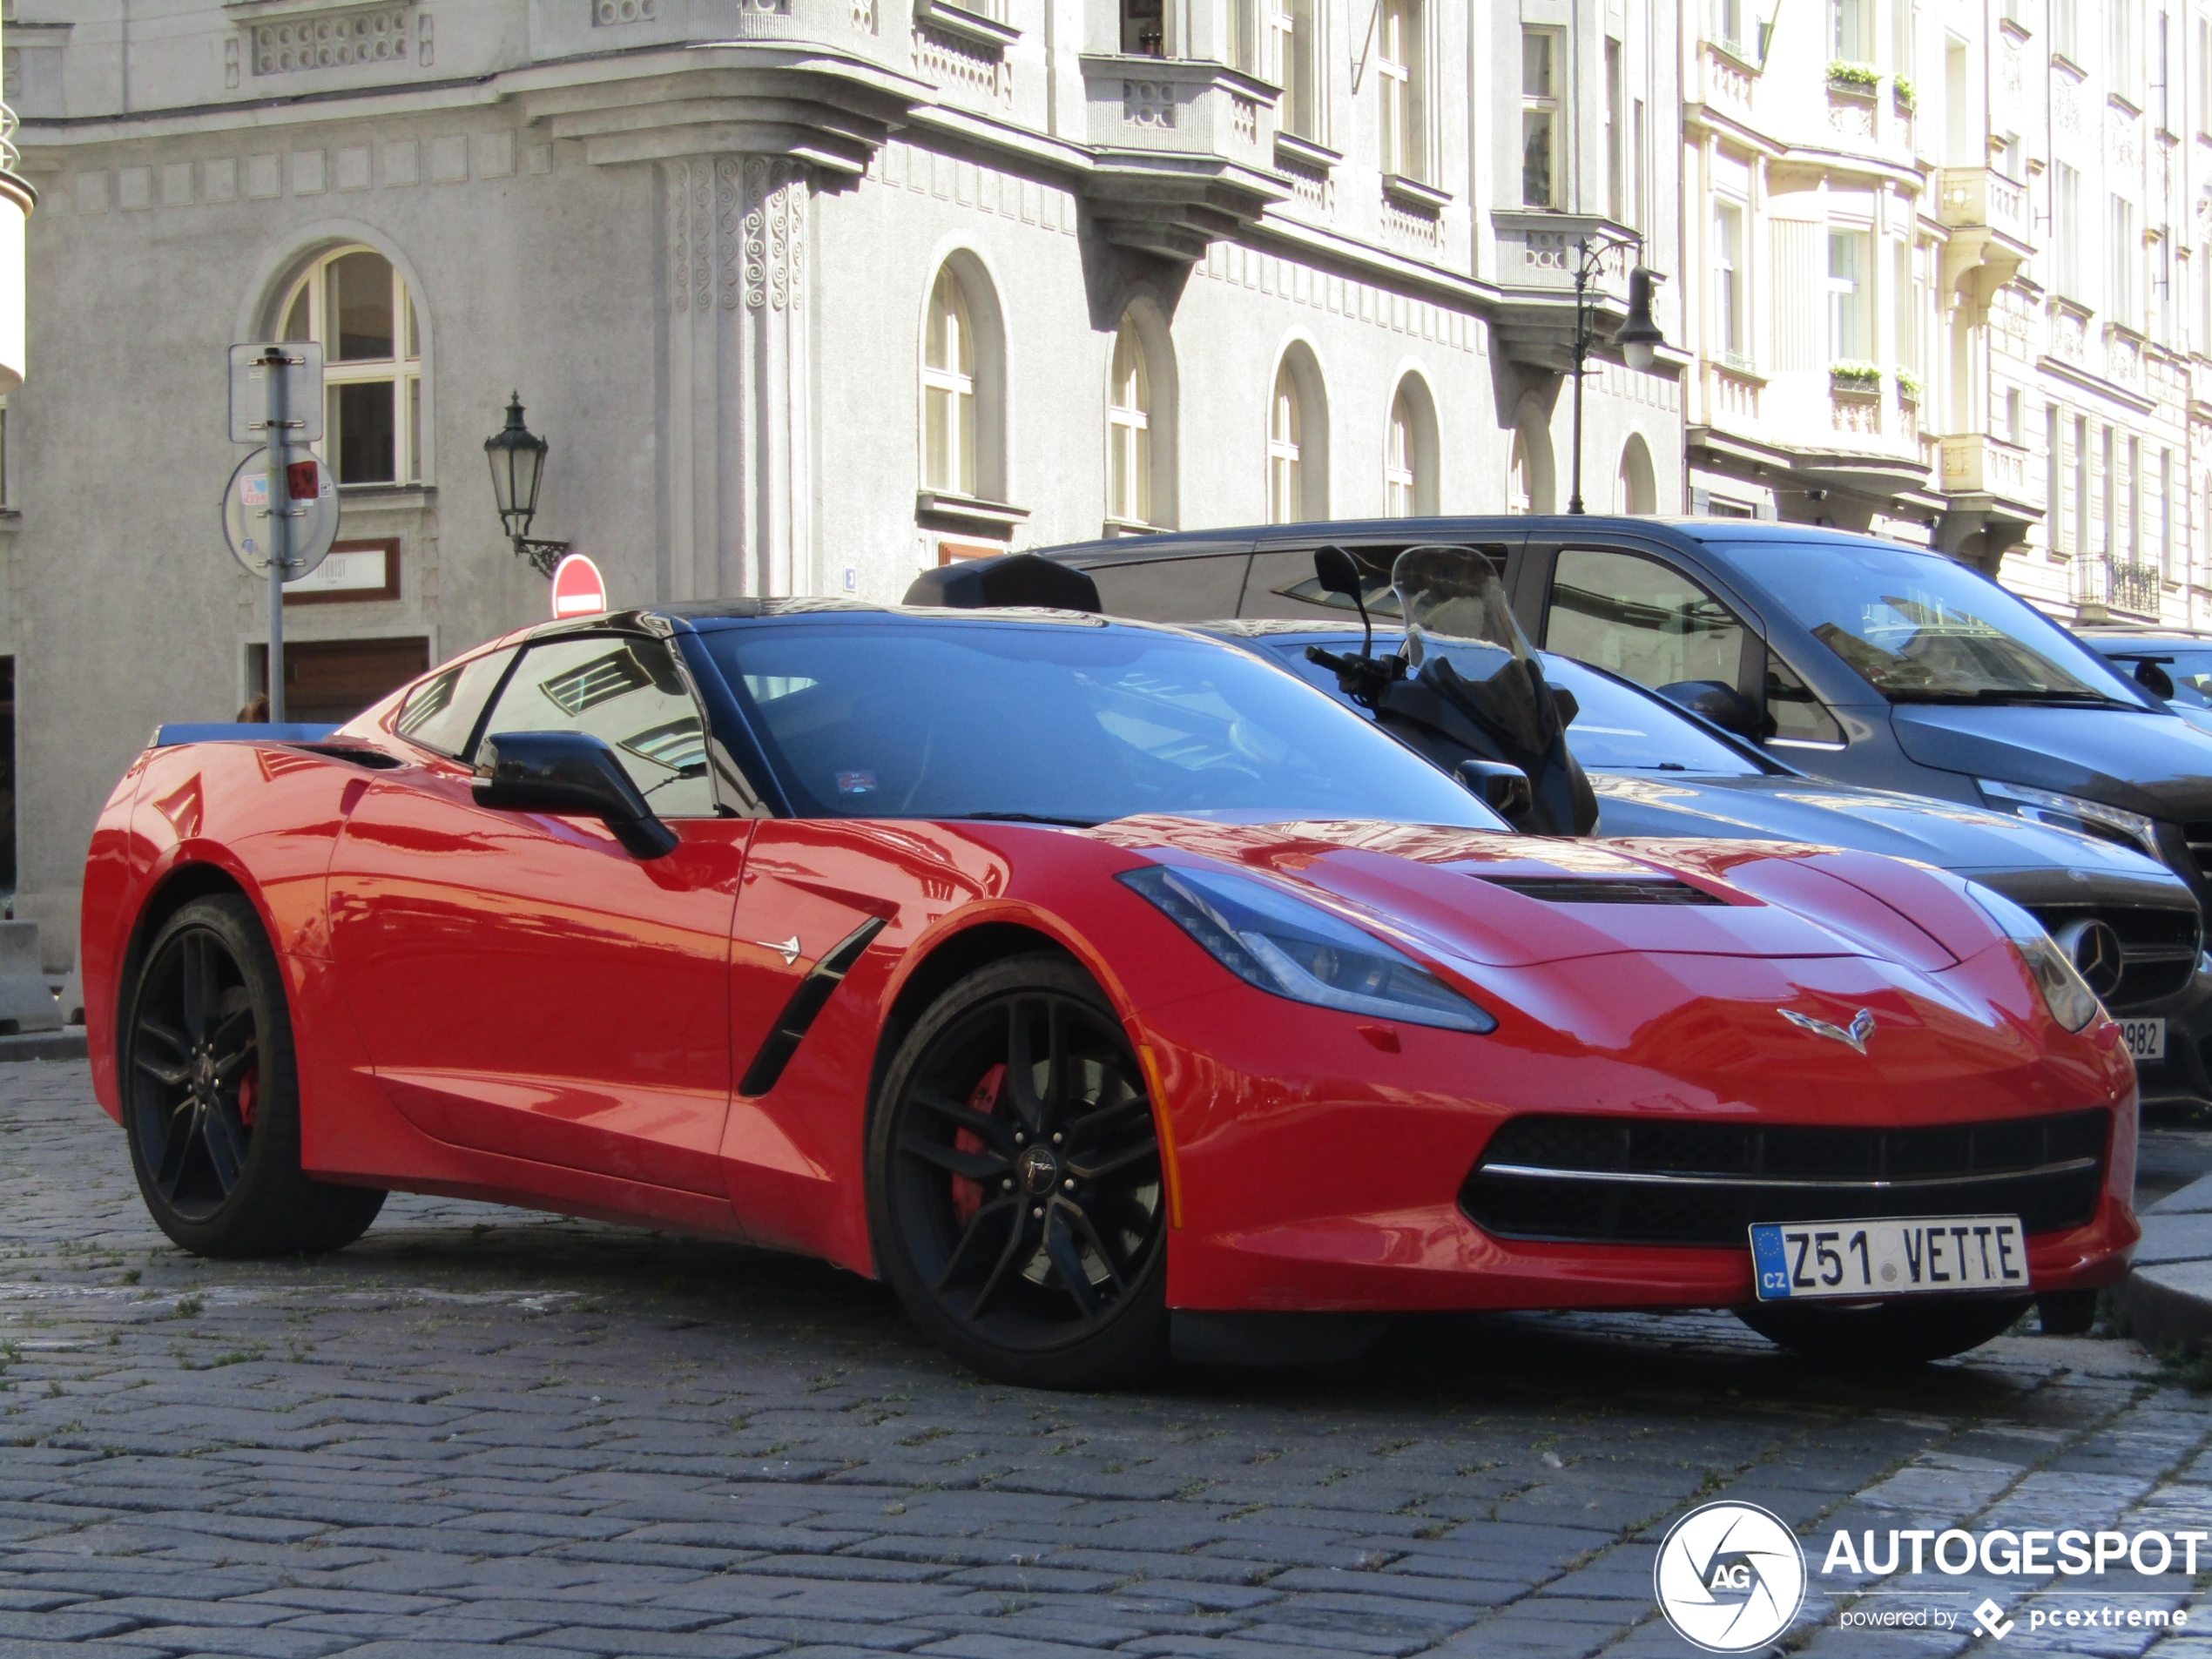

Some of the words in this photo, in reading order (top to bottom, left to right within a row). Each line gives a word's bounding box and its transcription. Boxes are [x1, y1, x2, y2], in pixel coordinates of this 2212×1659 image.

[2121, 1022, 2156, 1055] 982
[1785, 1230, 1871, 1287] Z51
[1903, 1225, 2020, 1283] VETTE
[1764, 1271, 1786, 1289] CZ
